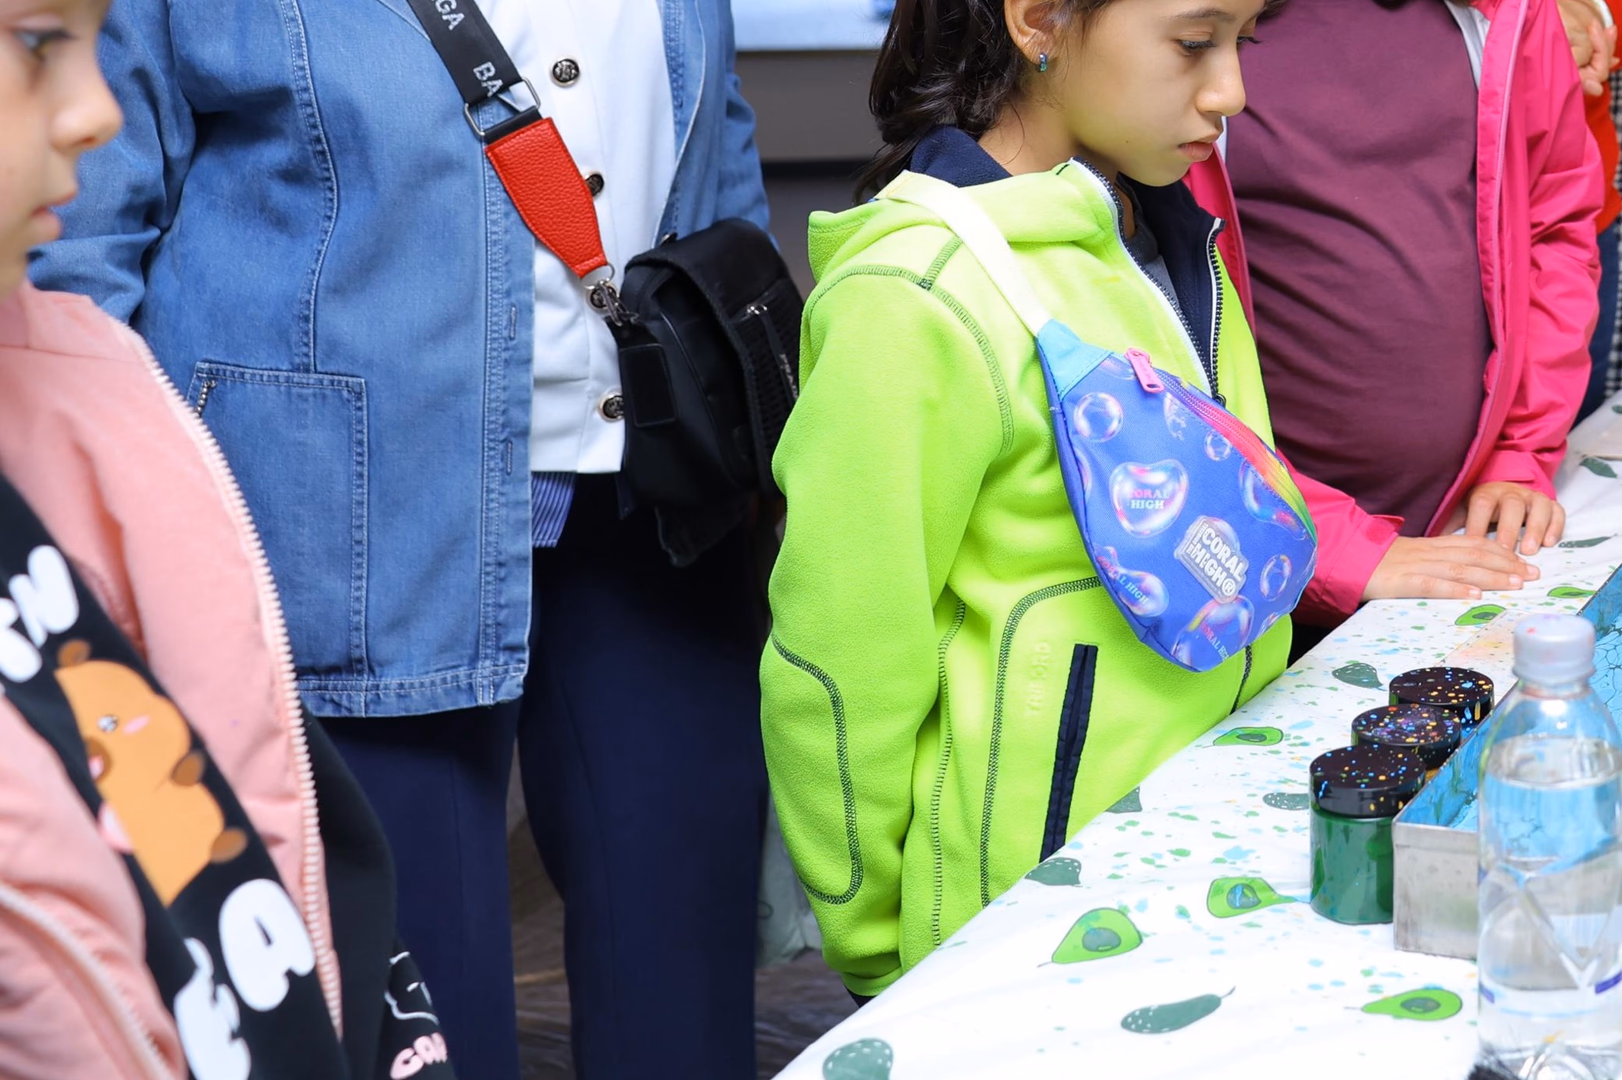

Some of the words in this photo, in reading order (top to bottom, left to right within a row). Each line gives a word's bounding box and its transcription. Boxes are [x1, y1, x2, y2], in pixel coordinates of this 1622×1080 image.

[1130, 499, 1165, 509] HIGH
[1202, 528, 1245, 581] CORAL
[1125, 581, 1150, 605] HIGH
